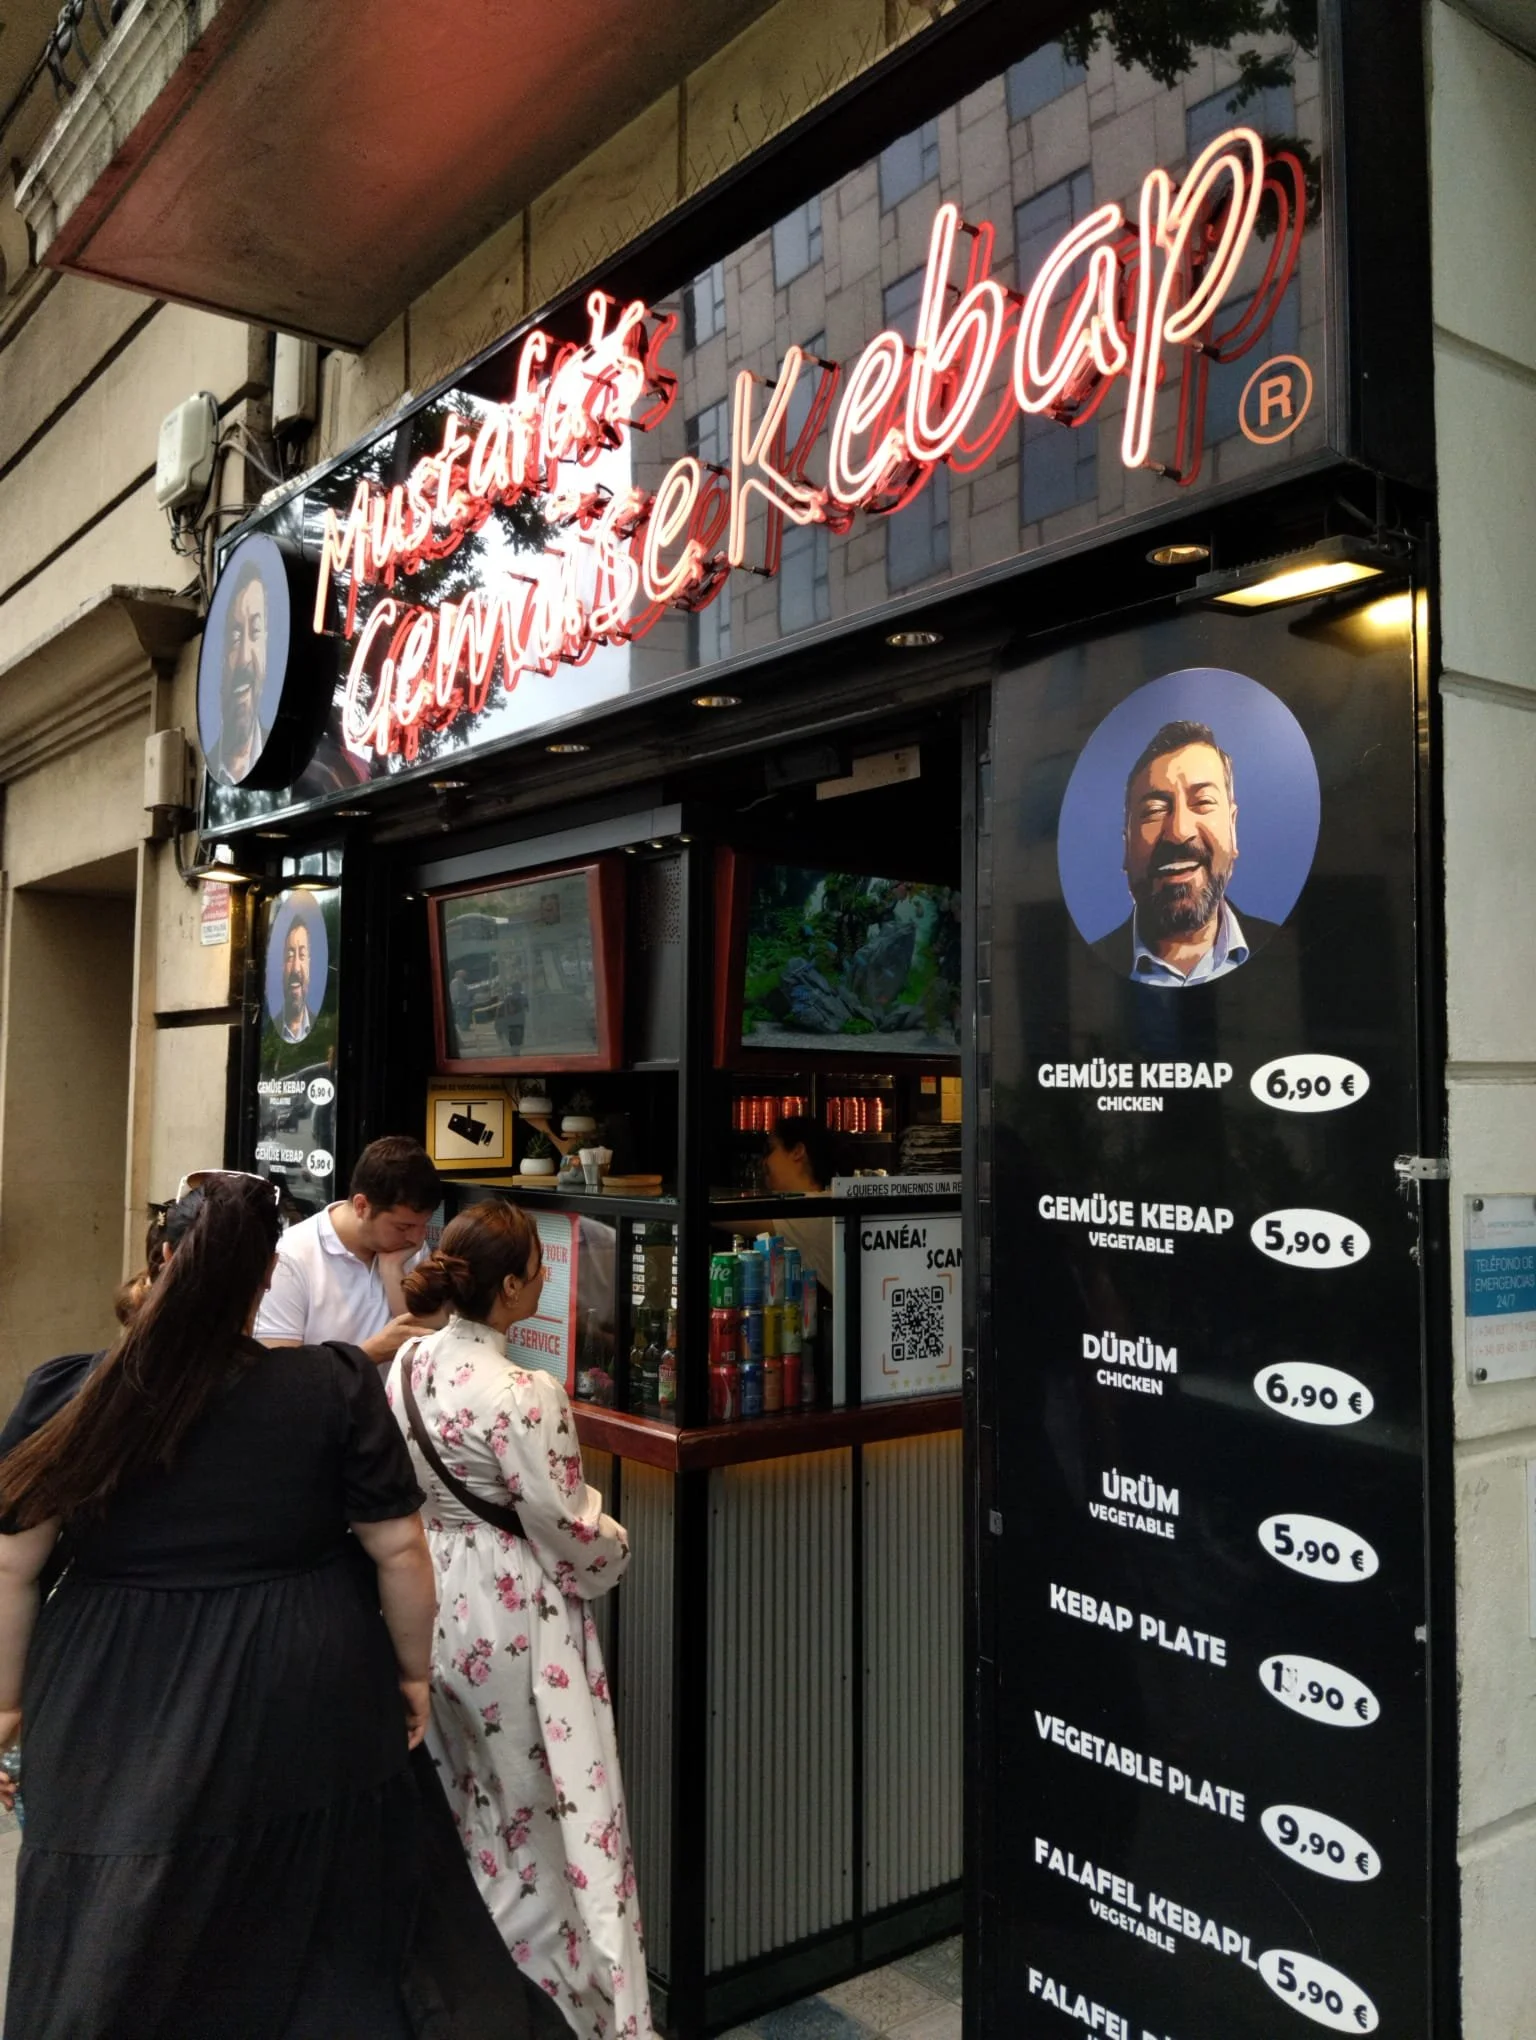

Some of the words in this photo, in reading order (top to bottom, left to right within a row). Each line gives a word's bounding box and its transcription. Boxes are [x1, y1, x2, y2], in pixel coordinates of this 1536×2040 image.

[728, 127, 1280, 568] Kebap
[1038, 1058, 1134, 1089] GEMÜSE
[1141, 1063, 1234, 1089] KEBAP
[1267, 1070, 1331, 1099] 6,90
[1341, 1074, 1355, 1098] €
[1097, 1096, 1164, 1112] CHICKEN
[847, 1184, 889, 1197] ¿QUIERES
[891, 1183, 934, 1195] PONERNOS
[935, 1182, 951, 1193] UNA
[1039, 1193, 1134, 1227] GEMÜSE
[1141, 1202, 1234, 1235] KEBAP
[862, 1224, 927, 1252] CANÉA!
[1089, 1231, 1175, 1255] VEGETABLE
[1265, 1220, 1331, 1255] 5,90
[1341, 1234, 1354, 1257] €
[1475, 1254, 1521, 1273] TELÉFONO
[1522, 1255, 1534, 1270] DE
[1474, 1274, 1536, 1292] EMERGENCIAS
[1496, 1293, 1516, 1309] 24/7
[520, 1327, 561, 1356] SERVICE
[1083, 1331, 1178, 1374] DÜRÜM
[1097, 1369, 1163, 1396] CHICKEN
[1266, 1373, 1338, 1410] 6,90
[1348, 1391, 1362, 1415] €
[1089, 1502, 1175, 1540] VEGETABLE
[1274, 1523, 1340, 1565] 5,90
[1350, 1549, 1364, 1572] €
[1050, 1583, 1134, 1633] KEBAP
[1140, 1613, 1227, 1667] PLATE
[1271, 1661, 1344, 1711] 1,90
[1354, 1697, 1368, 1721] €
[1034, 1711, 1163, 1788] VEGETABLE
[1168, 1766, 1245, 1823] PLATE
[1277, 1814, 1345, 1864] 9,90
[1355, 1852, 1369, 1875] €
[1034, 1837, 1142, 1913] FALAFEL
[1089, 1898, 1176, 1954] VEGETABLE
[1277, 1957, 1343, 2015] 5,90
[1354, 2004, 1367, 2029] €
